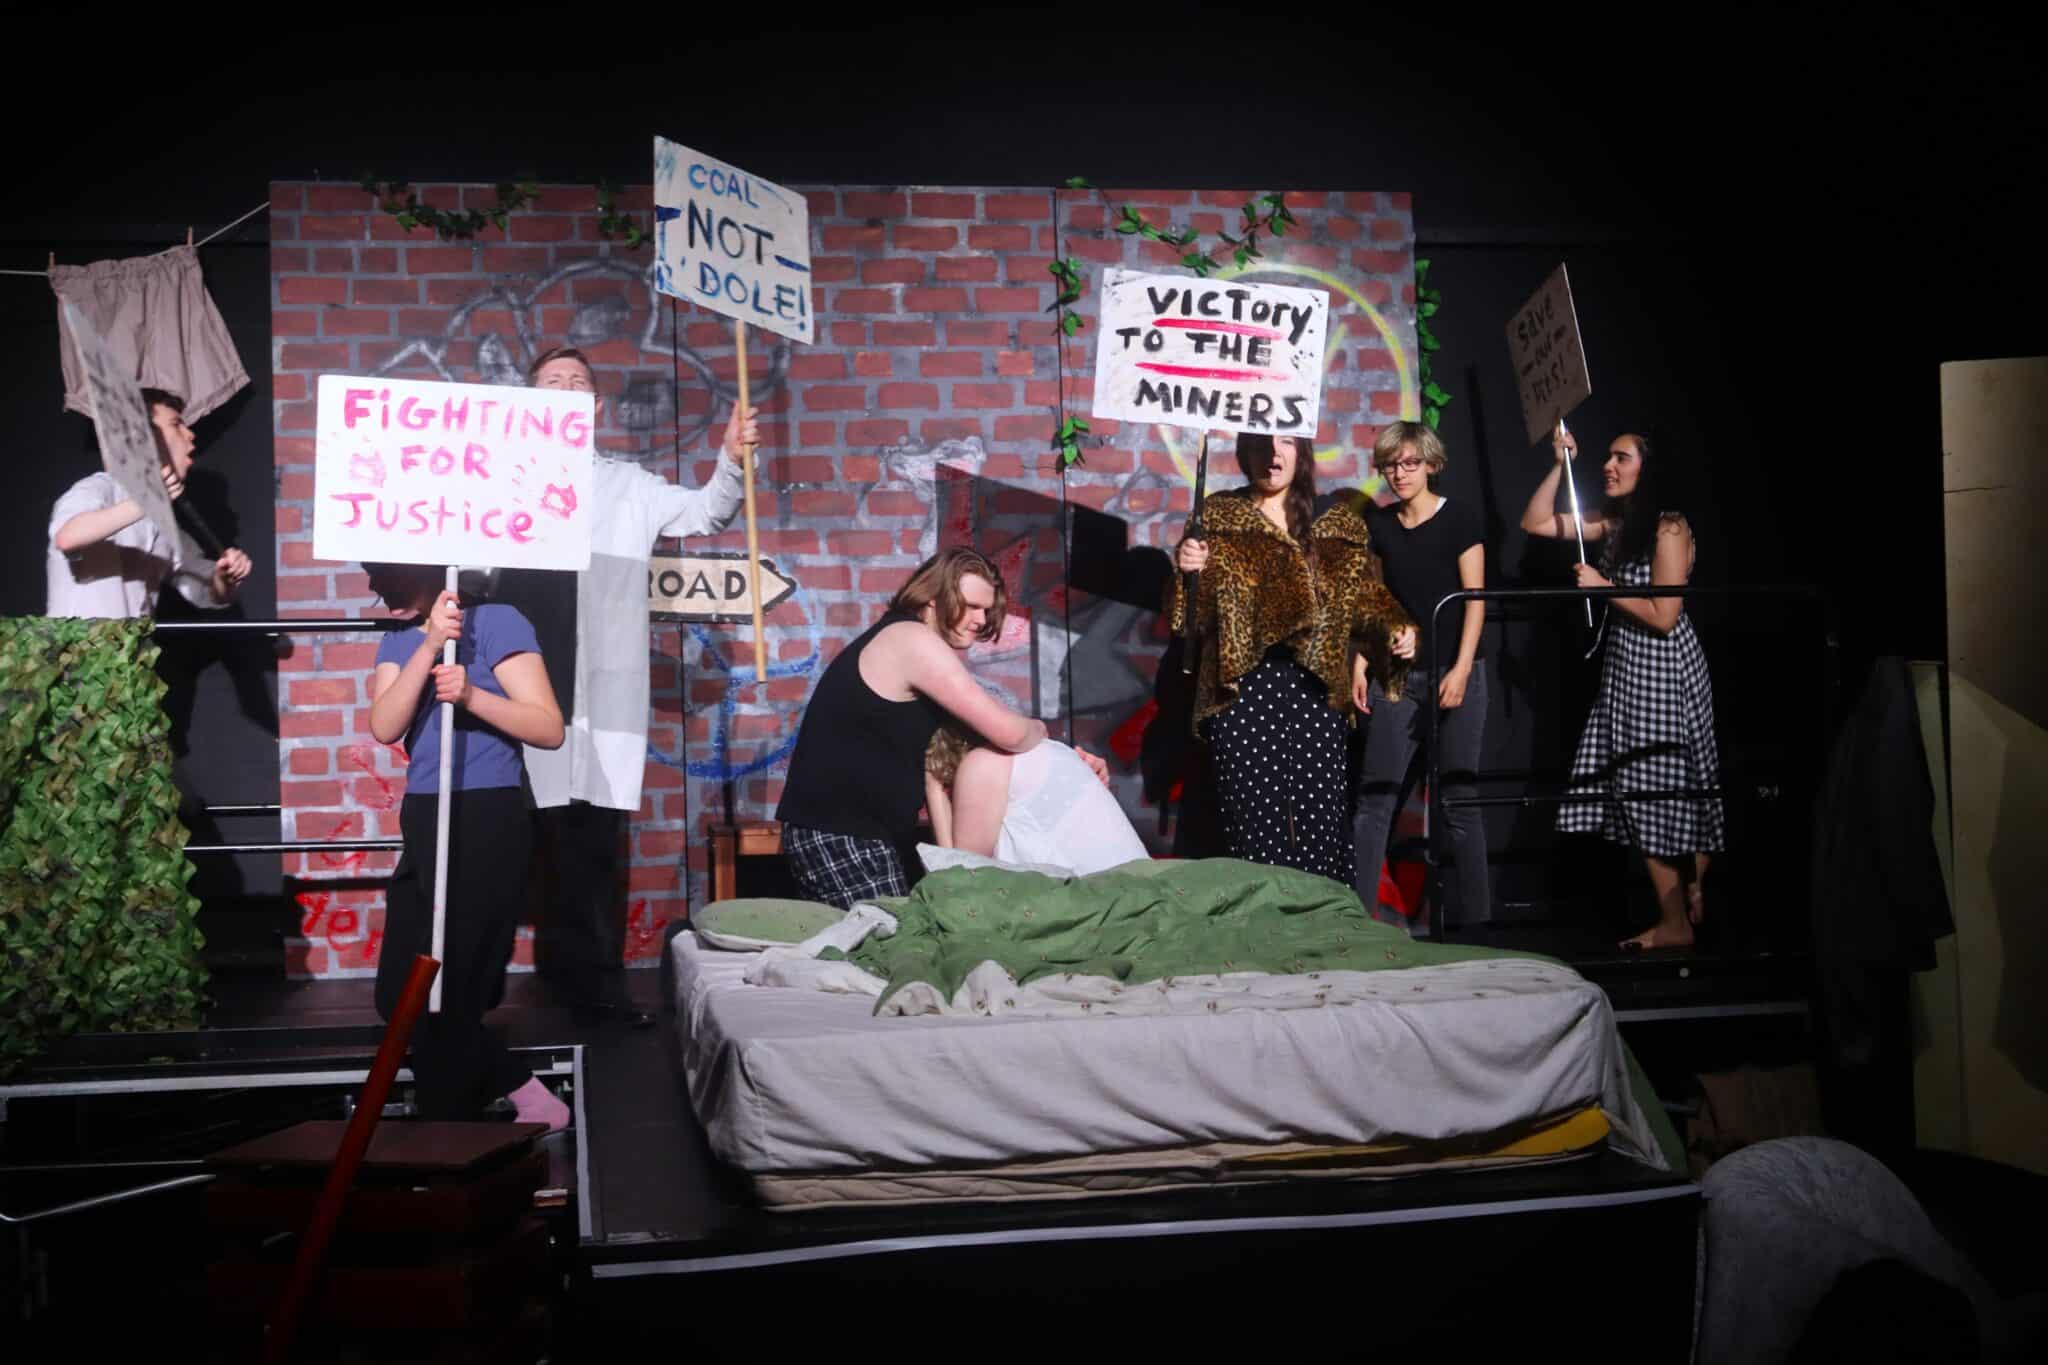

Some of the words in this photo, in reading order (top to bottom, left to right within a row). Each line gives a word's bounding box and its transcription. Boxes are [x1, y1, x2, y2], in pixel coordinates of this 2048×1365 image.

[688, 164, 759, 208] COAL
[688, 198, 774, 265] NOT
[695, 261, 806, 332] DOLE!
[1115, 327, 1165, 352] TO
[1185, 332, 1272, 367] THE
[1133, 378, 1308, 430] MINERS
[401, 442, 490, 479] FOR
[648, 569, 746, 601] OAD
